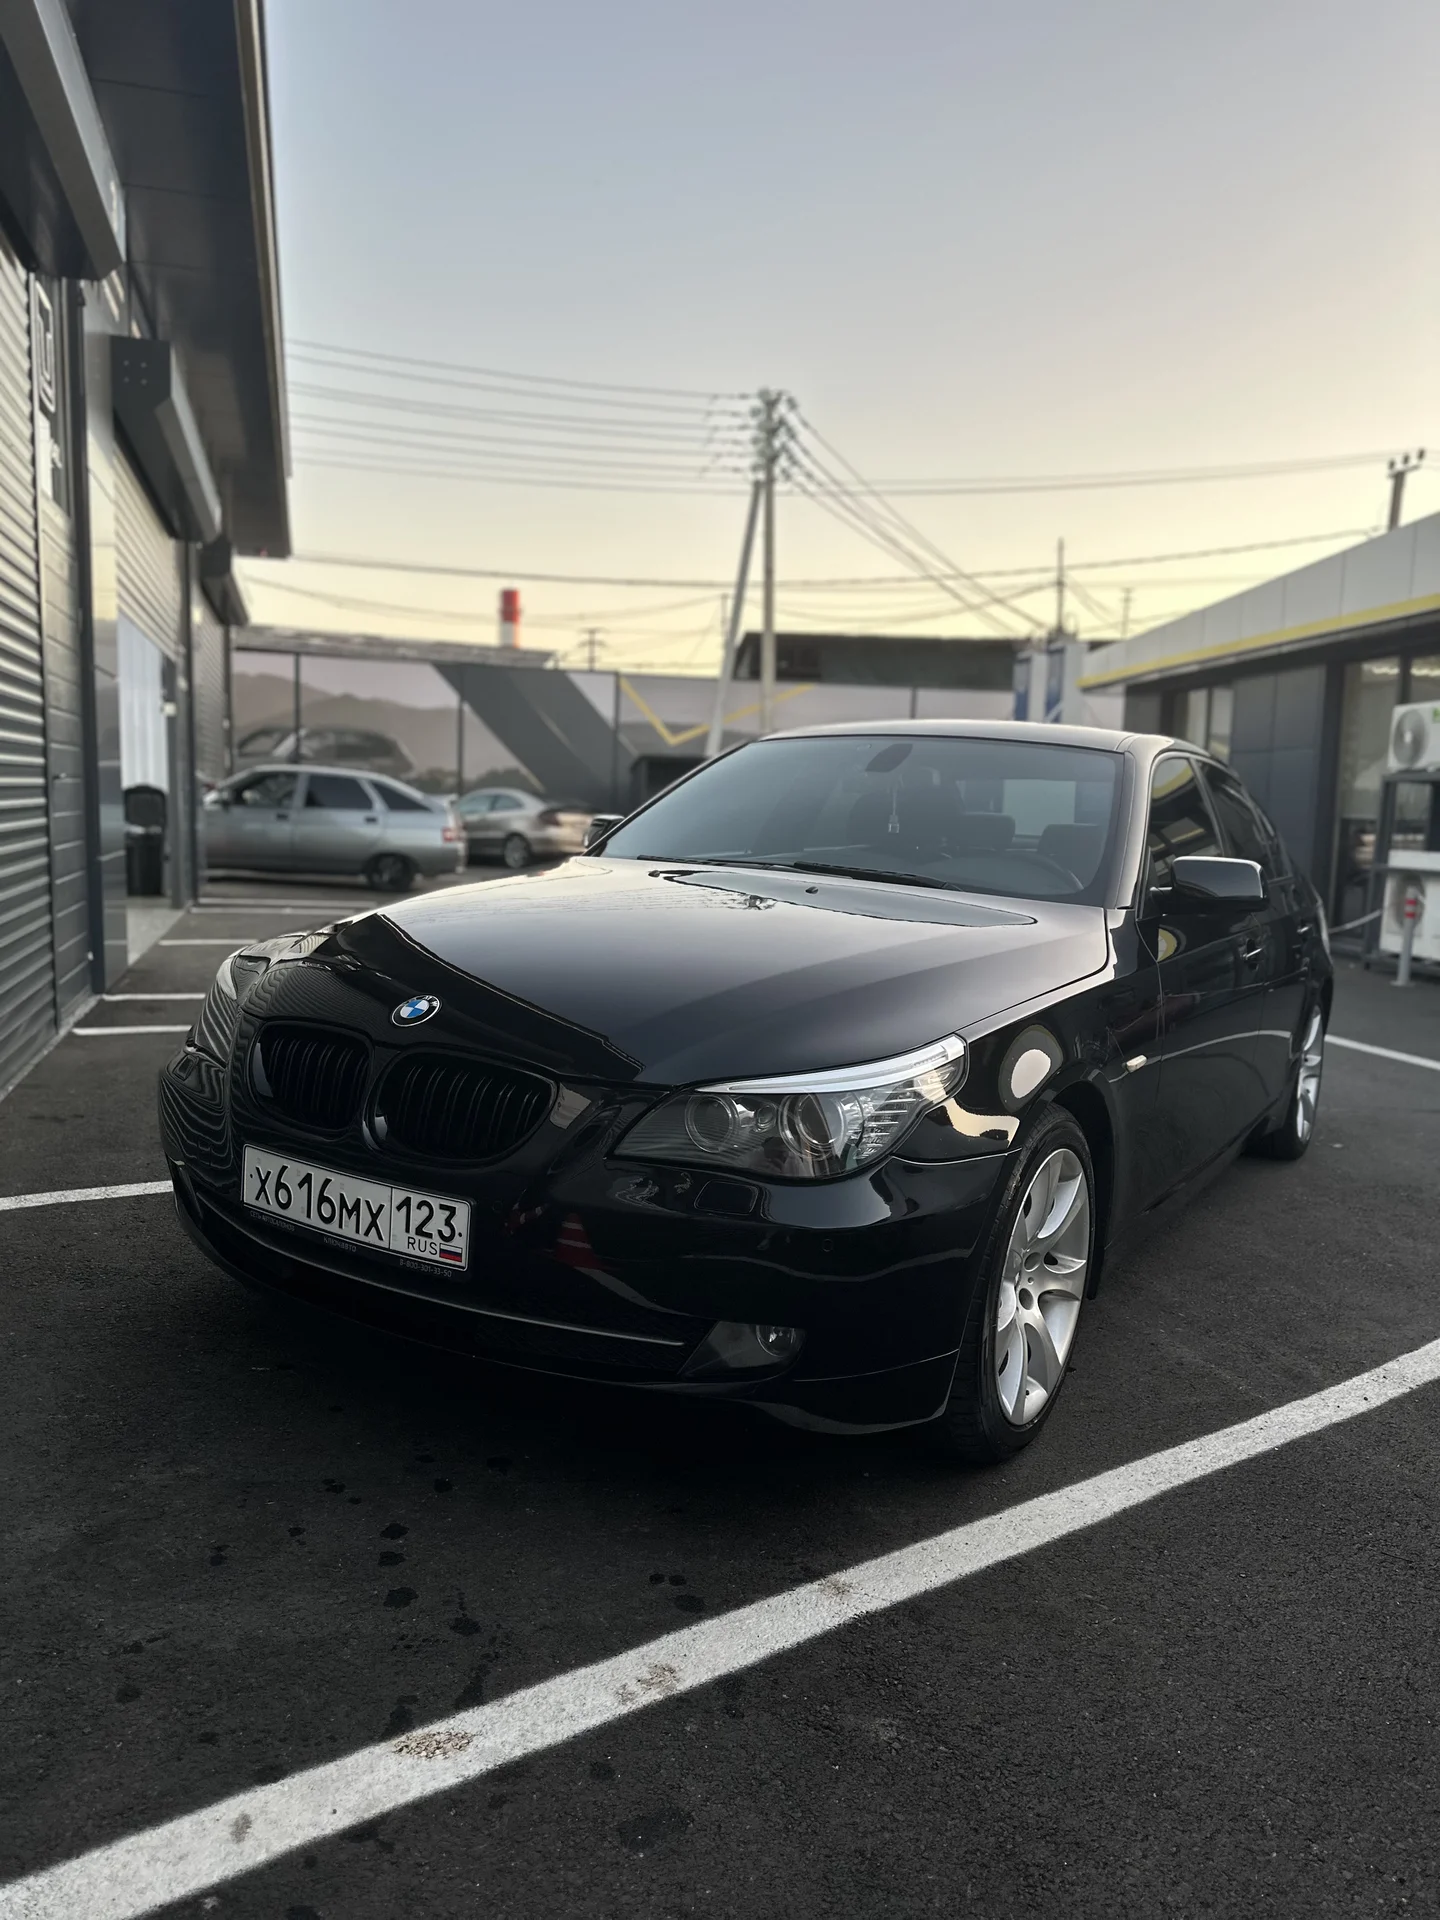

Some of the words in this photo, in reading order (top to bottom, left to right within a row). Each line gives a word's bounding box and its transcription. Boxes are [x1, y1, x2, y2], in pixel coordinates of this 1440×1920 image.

[249, 1210, 262, 1220] СЕТЬ
[396, 1196, 456, 1242] 123
[408, 1236, 438, 1255] RUS
